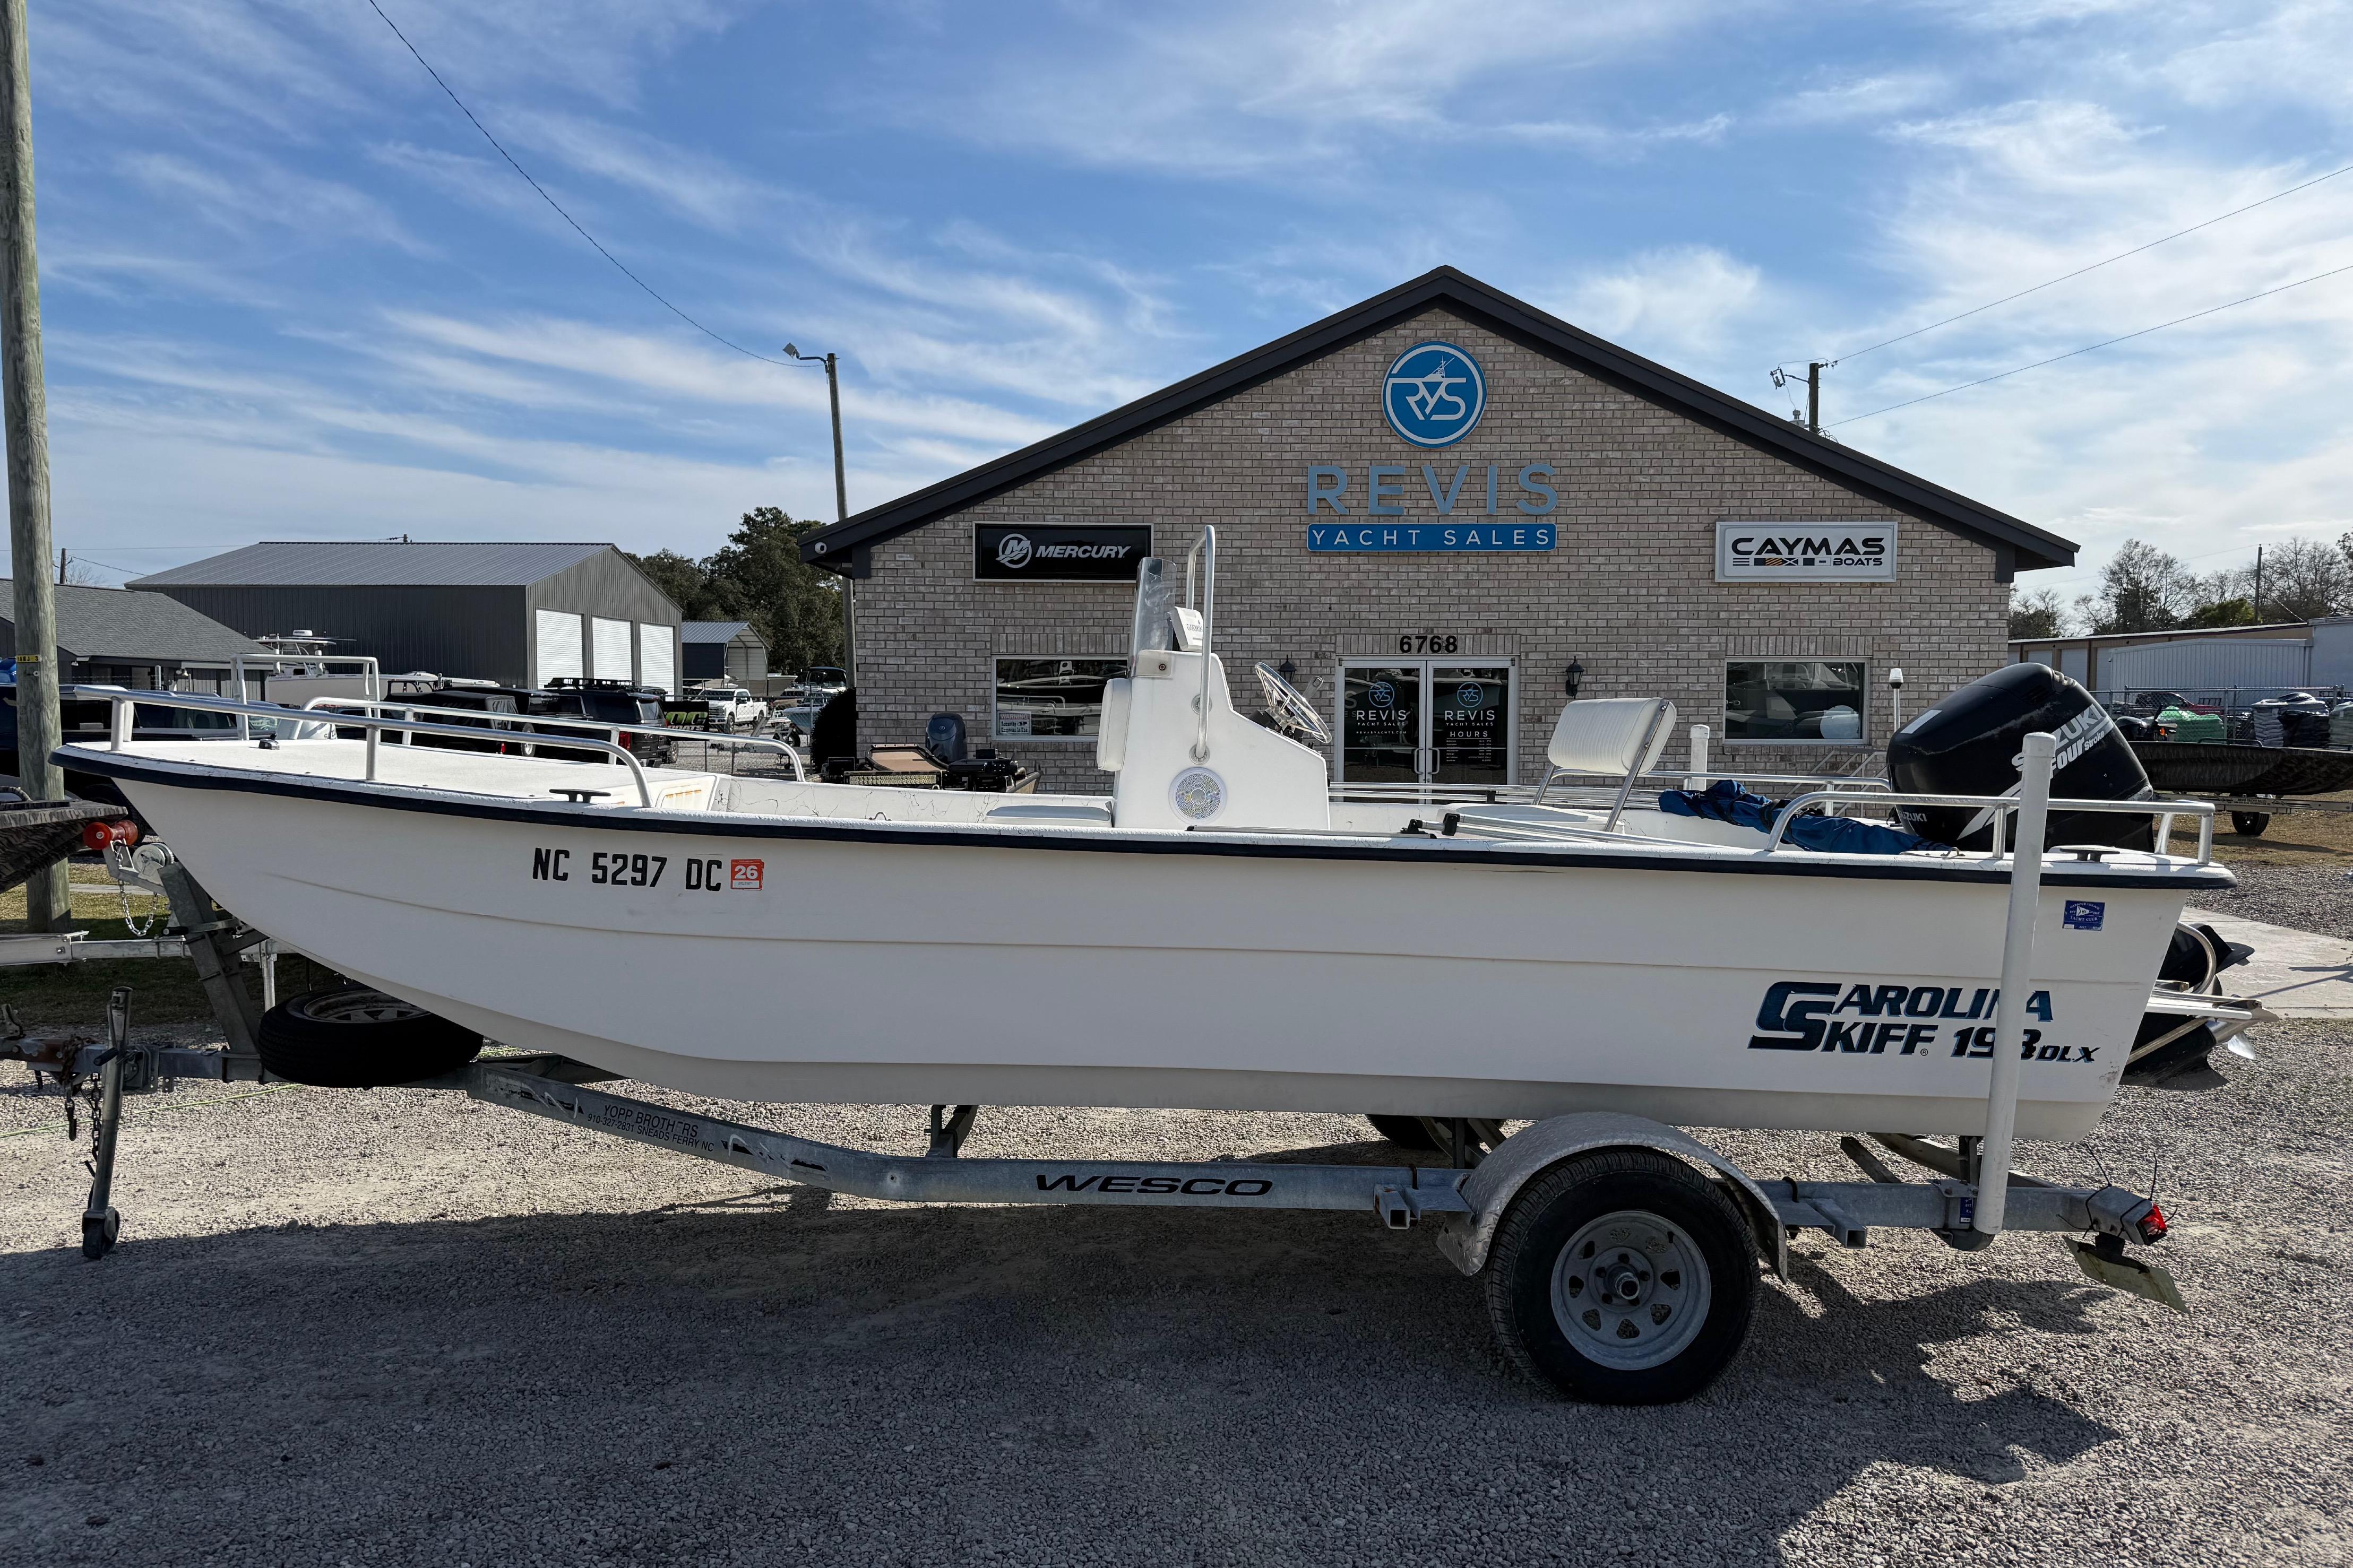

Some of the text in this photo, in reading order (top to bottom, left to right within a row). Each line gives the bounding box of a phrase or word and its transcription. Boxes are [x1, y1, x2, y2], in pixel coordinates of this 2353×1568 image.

[1307, 463, 1558, 515] REVIS
[1313, 530, 1549, 545] YACHT SALES
[1036, 545, 1132, 558] MERCURY
[1731, 538, 1885, 556] CAYMAS
[1833, 558, 1883, 566] BOATS
[1400, 635, 1458, 653] 6768
[1357, 710, 1407, 720] REVIS
[1445, 710, 1495, 721] REVIS
[2012, 704, 2103, 772] SZUKI
[2084, 730, 2105, 751] Stroke
[532, 847, 722, 891] NC 5297 DC
[735, 865, 758, 879] 26
[2035, 1045, 2101, 1063] DLX
[605, 1105, 633, 1121] YOPP
[588, 1113, 715, 1152] 910-327-2831 SNEADS FERRY NC
[1036, 1174, 1273, 1197] WESCO
